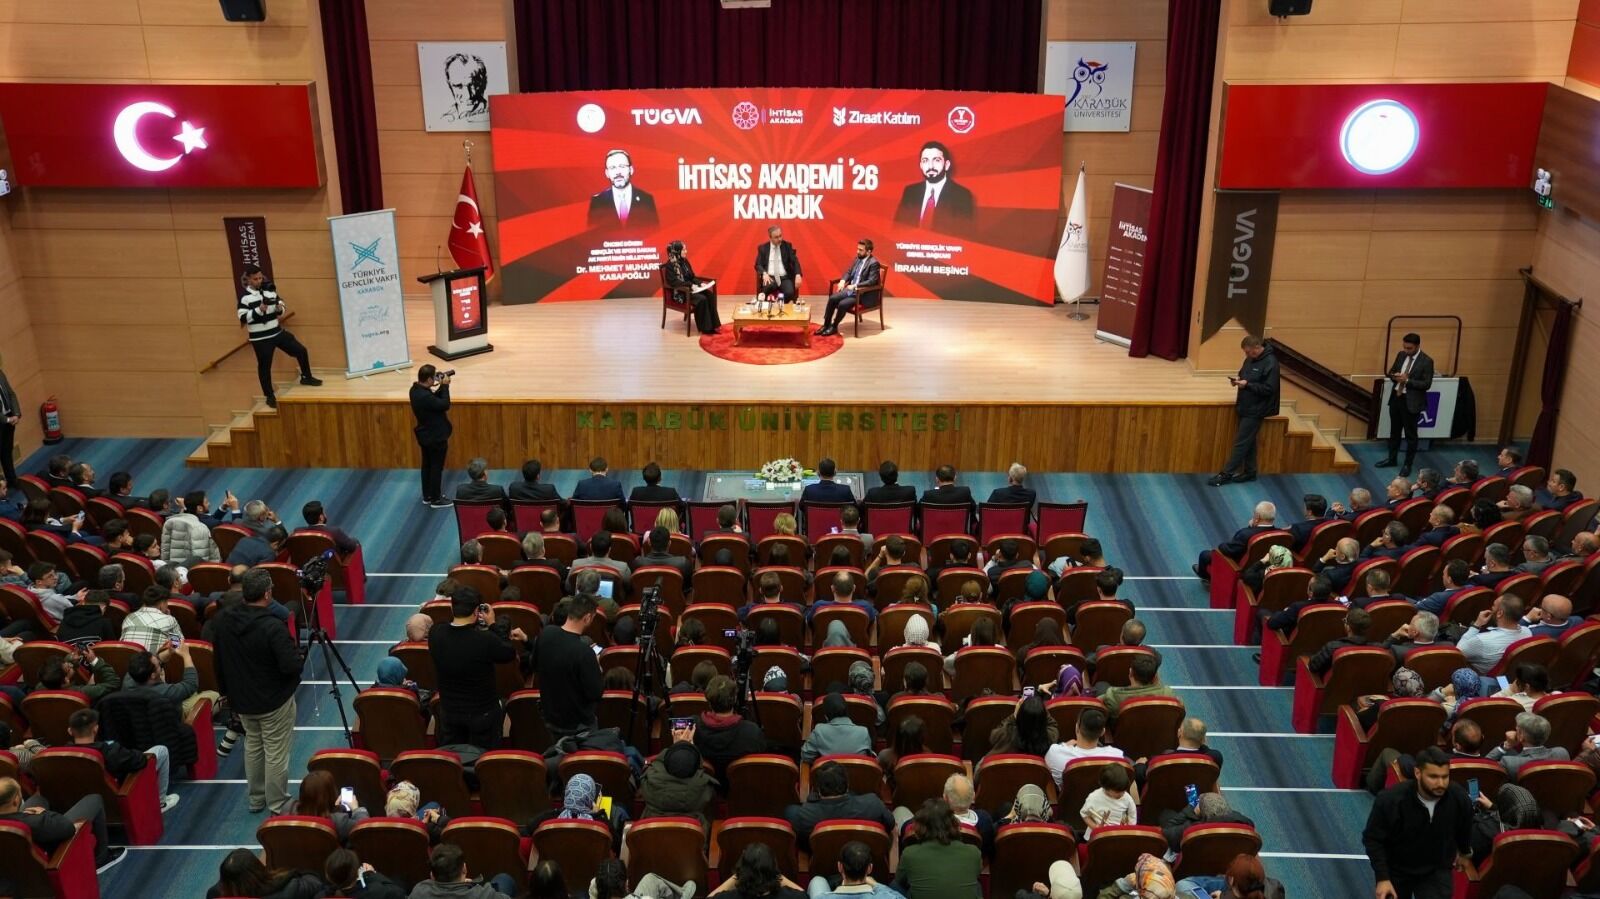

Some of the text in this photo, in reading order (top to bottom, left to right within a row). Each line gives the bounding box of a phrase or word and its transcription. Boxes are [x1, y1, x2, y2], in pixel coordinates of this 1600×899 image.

[1074, 97, 1127, 109] KARABÜK
[769, 108, 803, 117] İHTİSAS
[849, 110, 882, 125] Ziraat
[769, 117, 804, 125] AKADEMİ
[678, 157, 752, 190] İHTİSAS
[758, 158, 844, 192] AKADEMİ
[733, 188, 824, 220] KARABÜK
[352, 268, 386, 279] TÜRKİYE
[576, 262, 661, 274] Dr. MEHMET MUHARR
[894, 263, 968, 276] İBRAHİM BEŞİNCİ
[374, 274, 398, 283] VAKFI
[576, 408, 961, 431] KARABÜK ÜNİVERSİTESİ
